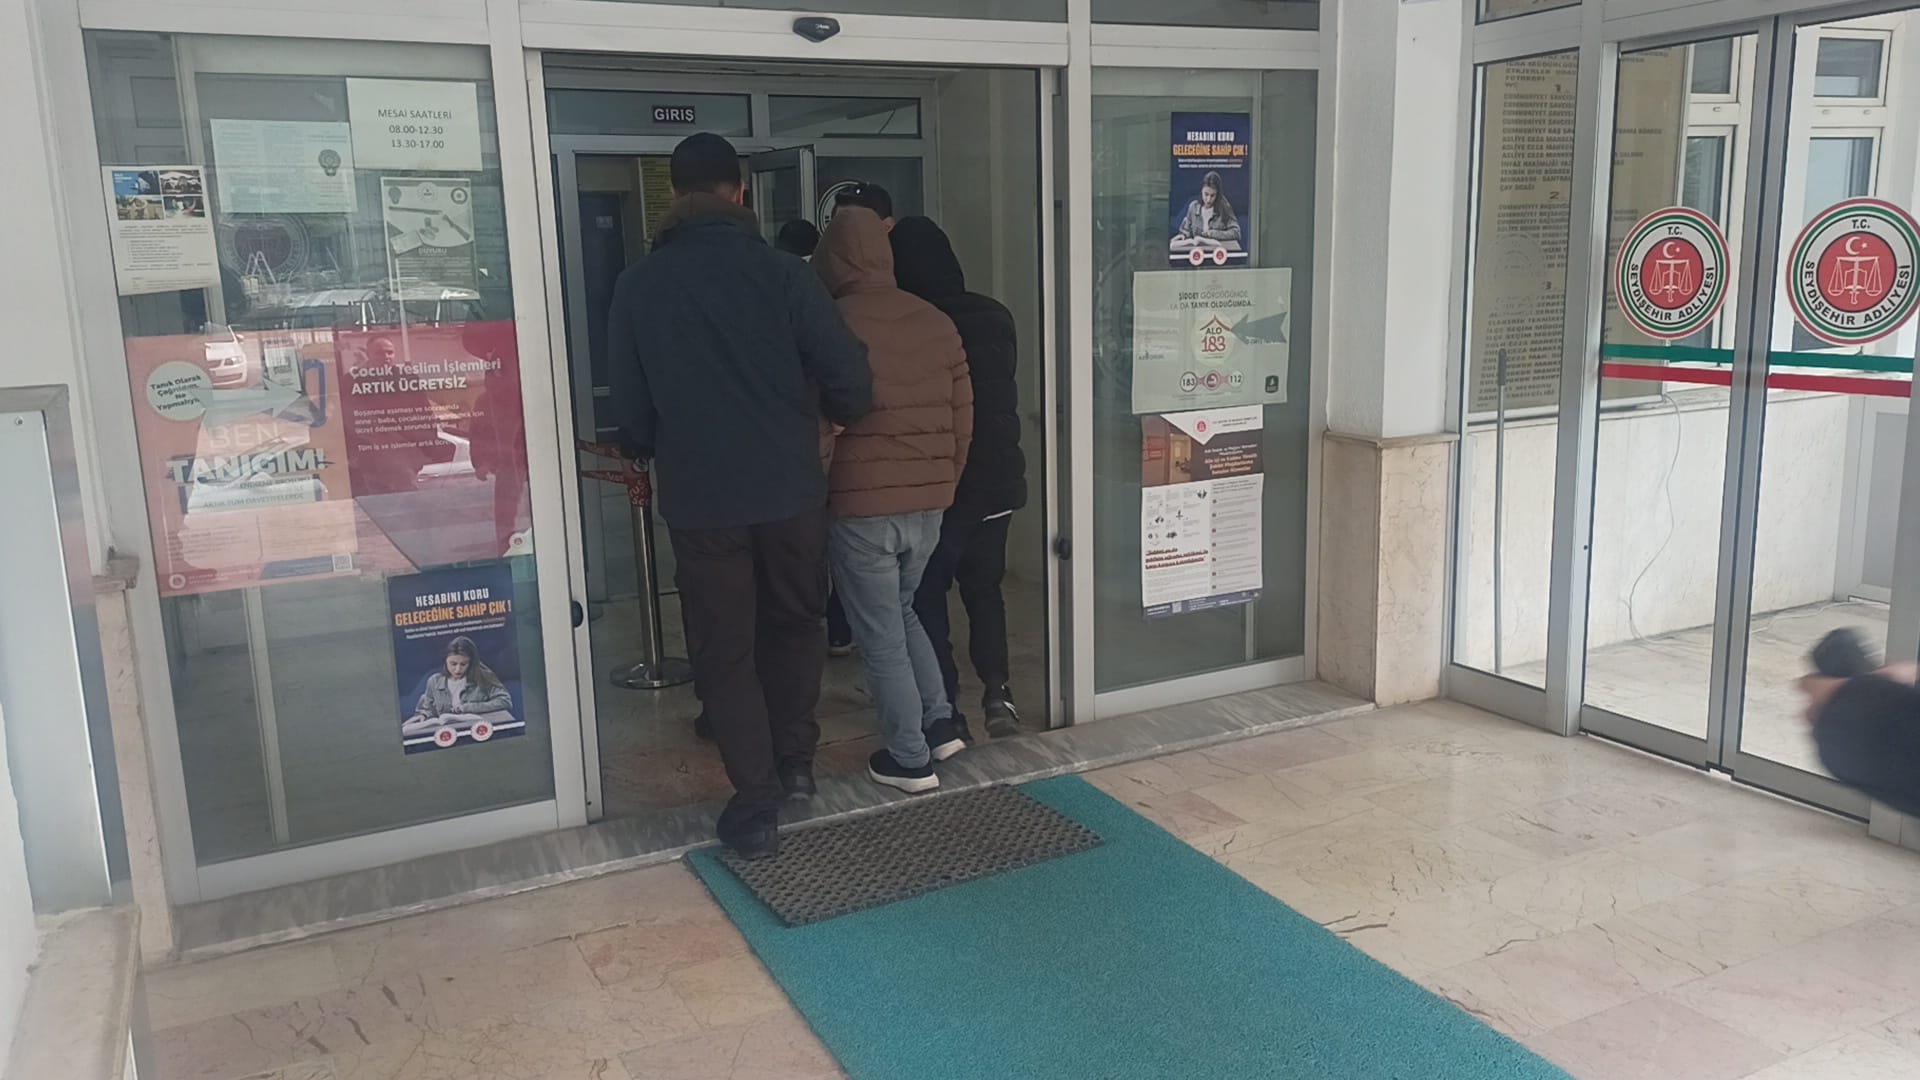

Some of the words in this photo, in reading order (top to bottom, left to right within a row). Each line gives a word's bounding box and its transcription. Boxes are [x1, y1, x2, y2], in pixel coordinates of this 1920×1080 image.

[378, 109, 408, 118] MESAİ
[409, 109, 452, 119] SAATLERİ
[654, 108, 694, 122] GİRİŞ
[388, 125, 443, 135] 08.00-12.30
[391, 139, 444, 149] 13.30-17.00
[1852, 218, 1871, 229] T.C.
[1667, 226, 1682, 236] T.C.
[1630, 263, 1672, 321] SEYDİŞEHİR
[1678, 266, 1715, 320] ADLİYESİ
[1804, 260, 1856, 326] SEYDİŞEHİR
[1863, 264, 1911, 324] ADLİYESİ
[1205, 326, 1223, 336] ALO
[1201, 335, 1226, 353] 183
[350, 364, 393, 379] Çocuk
[396, 361, 441, 376] Teslim
[444, 357, 502, 374] İşlemleri
[351, 379, 396, 395] ARTIK
[398, 374, 468, 392] ÜCRETSİZ
[1182, 377, 1195, 387] 183
[1230, 374, 1242, 384] 112
[209, 421, 278, 449] BEN
[415, 591, 461, 607] HESABINI
[463, 587, 490, 602] KORU
[394, 606, 455, 627] GELECEĞİNE
[456, 601, 488, 619] SAHİP
[488, 600, 507, 617] ÇIK
